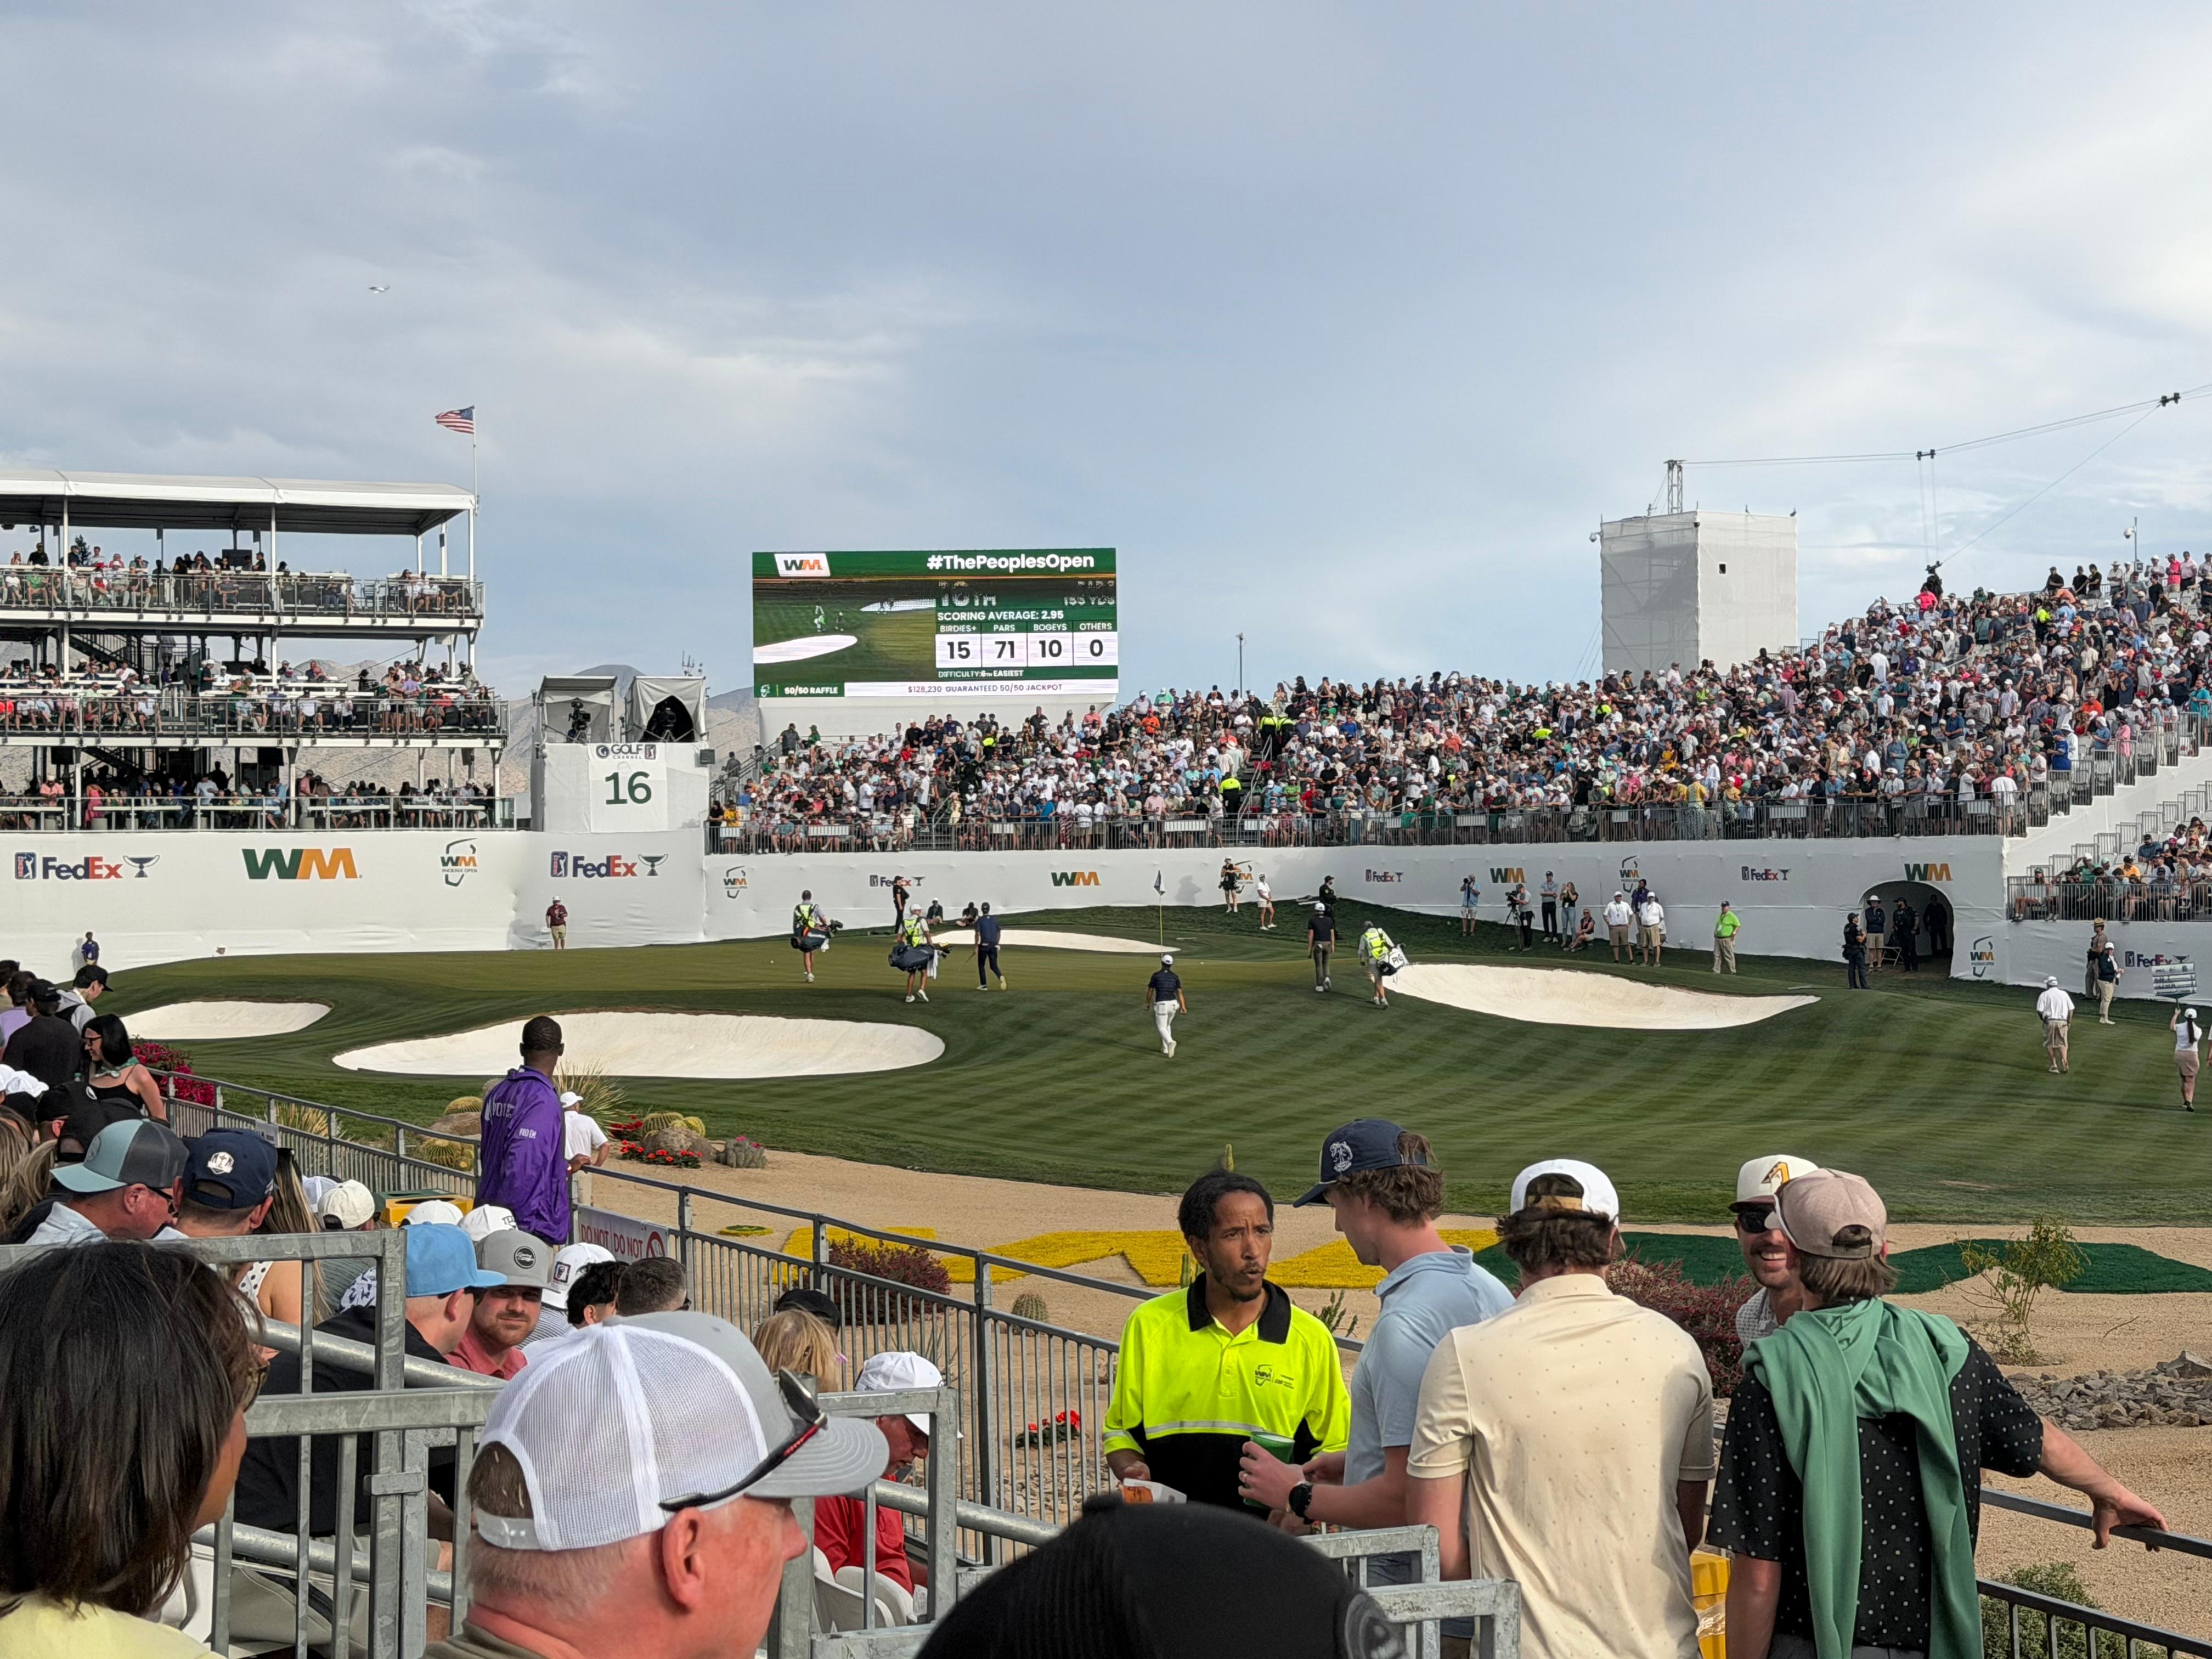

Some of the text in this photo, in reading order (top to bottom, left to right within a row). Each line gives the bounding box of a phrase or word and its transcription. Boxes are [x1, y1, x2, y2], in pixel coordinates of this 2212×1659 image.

[783, 560, 823, 571] WM
[927, 554, 1094, 573] #ThePeoplesOpen
[938, 610, 1064, 621] SCORING AVERAGE: 2.95
[1079, 622, 1113, 630] OTHERS
[947, 641, 970, 659] 15
[995, 641, 1015, 658] 71
[1039, 640, 1062, 658] 10
[1090, 639, 1103, 657] 0
[784, 686, 808, 696] 50/50
[1000, 684, 1024, 692] 50/50
[611, 744, 643, 754] GOLF
[605, 771, 652, 804] 16
[42, 857, 123, 879] FedEx
[241, 848, 358, 879] WM
[441, 856, 477, 867] WM
[573, 855, 637, 878] FedEx
[1051, 872, 1100, 886] WM
[1490, 868, 1526, 883] WM
[1620, 870, 1639, 878] WM
[1751, 868, 1779, 881] FedEx
[1904, 864, 1952, 881] WM
[880, 877, 911, 887] Fex
[1970, 952, 1994, 961] WM
[581, 1224, 609, 1248] DO NOT
[614, 1233, 644, 1259] DO NOT
